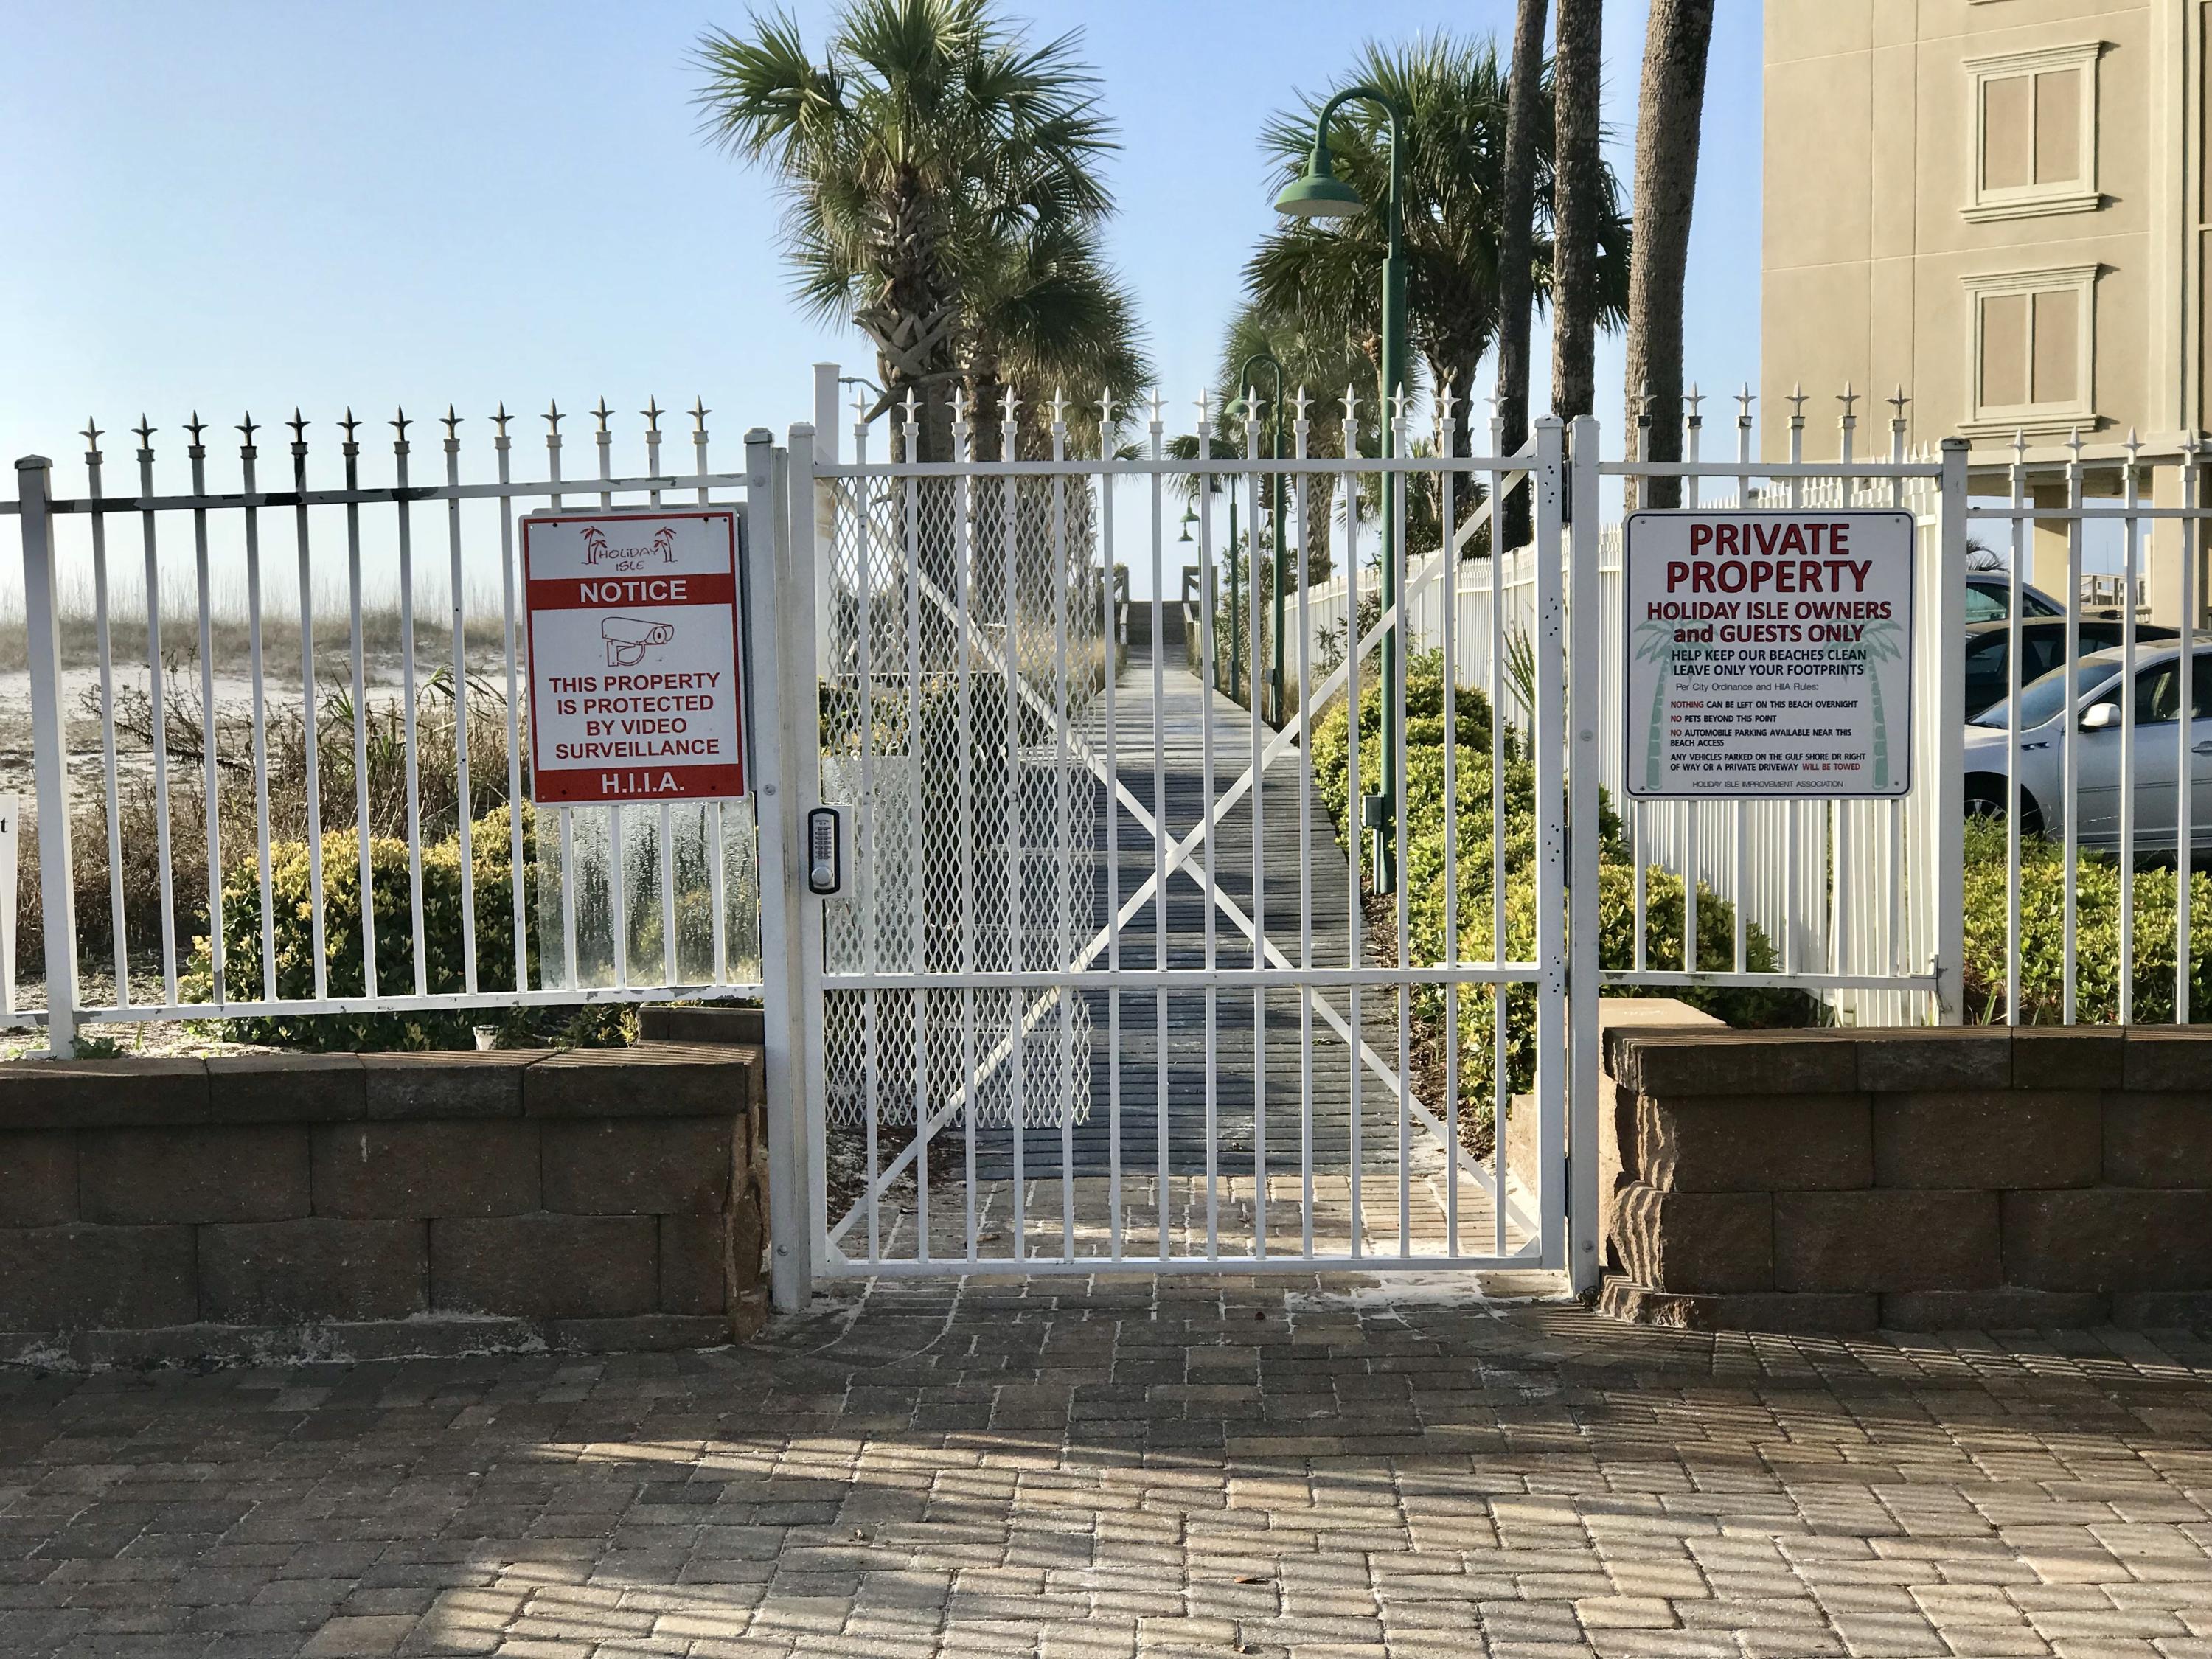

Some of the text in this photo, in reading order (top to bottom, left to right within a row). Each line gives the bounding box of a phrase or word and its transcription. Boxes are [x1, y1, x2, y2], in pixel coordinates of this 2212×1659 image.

[1690, 524, 1850, 556] PRIVATE
[616, 560, 645, 571] ISLE
[1666, 560, 1873, 593] PROPERTY
[580, 580, 687, 603] NOTICE
[1647, 601, 1892, 620] HOLIDAY ISLE OWNERS
[1674, 624, 1865, 643] and GUESTS ONLY
[1672, 650, 1867, 661] HELP KEEP OUR BEACHES CLEAN
[1674, 664, 1864, 675] LEAVE ONLY YOUR FOOTPRINTS
[549, 672, 720, 693] THIS PROPERTY
[1676, 683, 1689, 691] Per
[1692, 683, 1709, 692] City
[1711, 683, 1753, 691] Ordinance
[1756, 683, 1772, 691] and
[1793, 683, 1819, 691] Rules:
[557, 695, 714, 715] IS PROTECTED
[586, 717, 687, 736] BY VIDEO
[555, 739, 720, 759] SURVEILLANCE
[602, 772, 685, 793] H.I.I.A.
